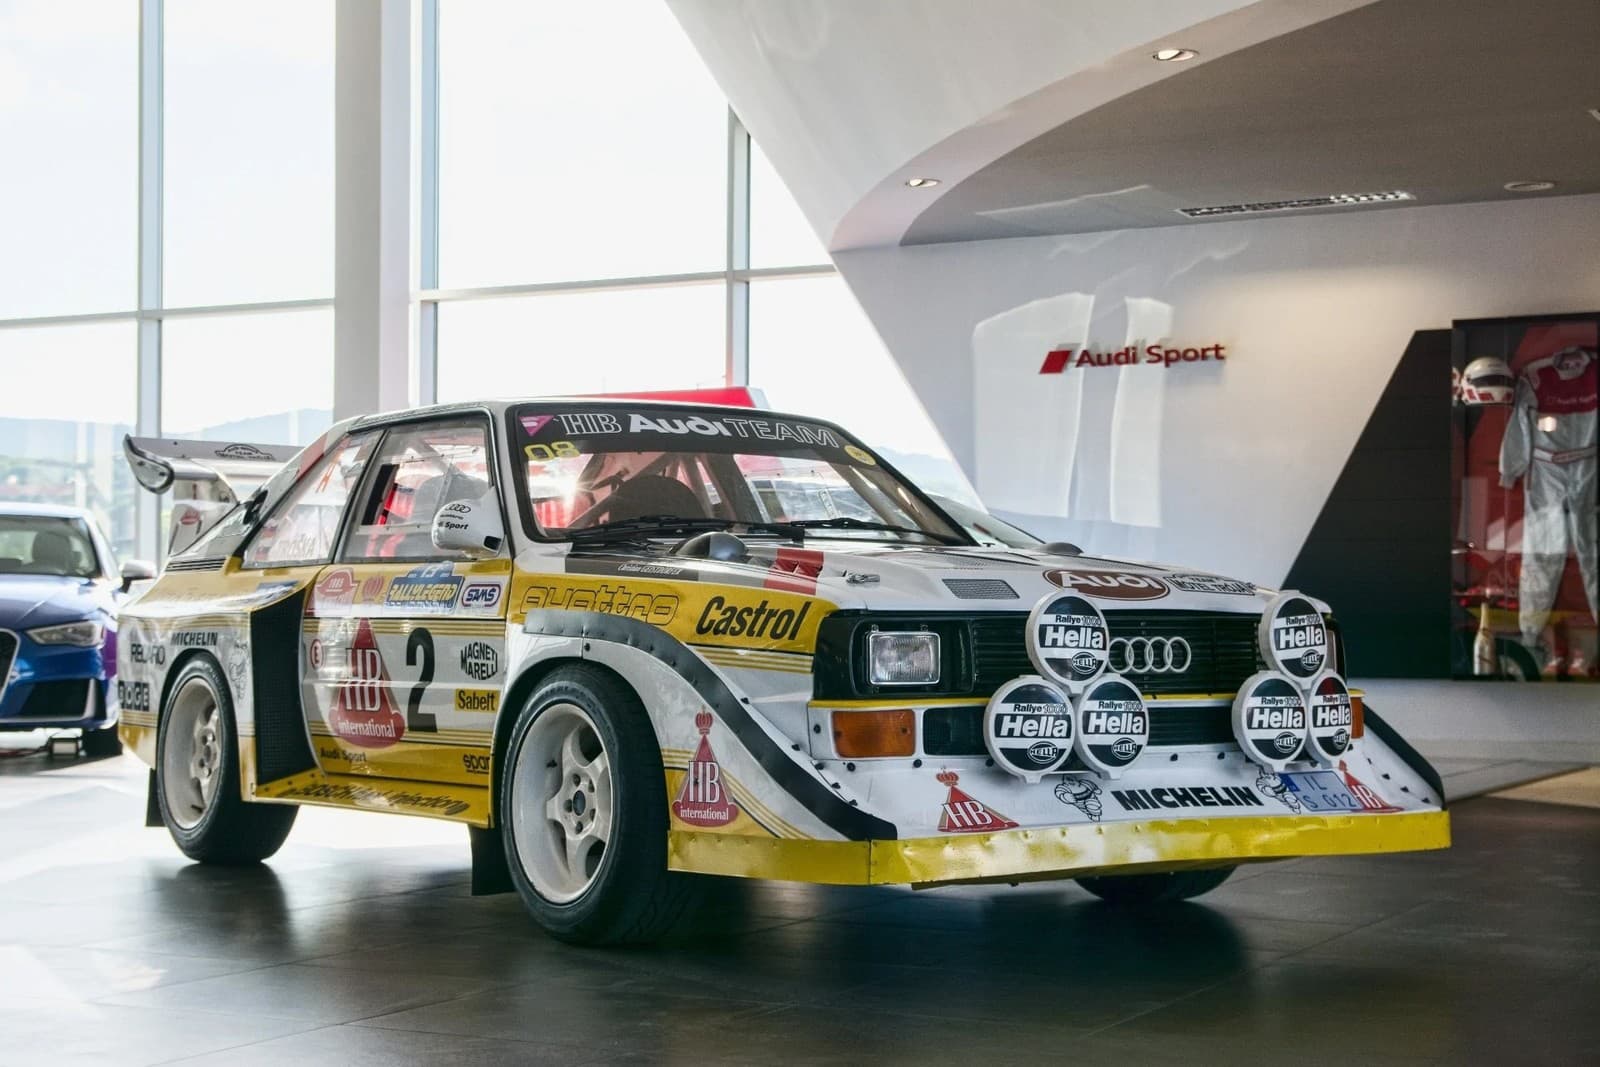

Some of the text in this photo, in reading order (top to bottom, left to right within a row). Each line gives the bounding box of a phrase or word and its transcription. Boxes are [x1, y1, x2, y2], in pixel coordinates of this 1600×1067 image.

[1075, 344, 1225, 368] Audi Sport
[557, 413, 839, 448] HB Audi TEAM
[524, 441, 581, 461] 08
[444, 521, 469, 530] Sport
[1058, 571, 1163, 589] Audi
[466, 588, 496, 602] SAMS
[520, 584, 680, 626] quattro
[696, 596, 812, 641] Castrol
[1055, 615, 1081, 625] Rallye
[171, 631, 218, 647] MICHELIN
[1044, 626, 1104, 648] Hella
[1279, 627, 1323, 649] Hella
[344, 648, 382, 711] HB
[406, 627, 437, 733] 2
[458, 690, 496, 711] Sabelt
[1013, 704, 1042, 714] Rallye
[1099, 700, 1123, 710] Rallye
[1261, 697, 1283, 706] Rallye
[338, 716, 396, 738] international
[1000, 715, 1068, 737] Hella
[1087, 713, 1144, 734] Hella
[1251, 708, 1303, 729] Hella
[1316, 706, 1351, 727] Hella
[688, 760, 721, 803] HB
[1110, 787, 1264, 812] MICHELIN
[1350, 784, 1382, 808] HB
[680, 805, 729, 821] international
[943, 800, 993, 828] HB
